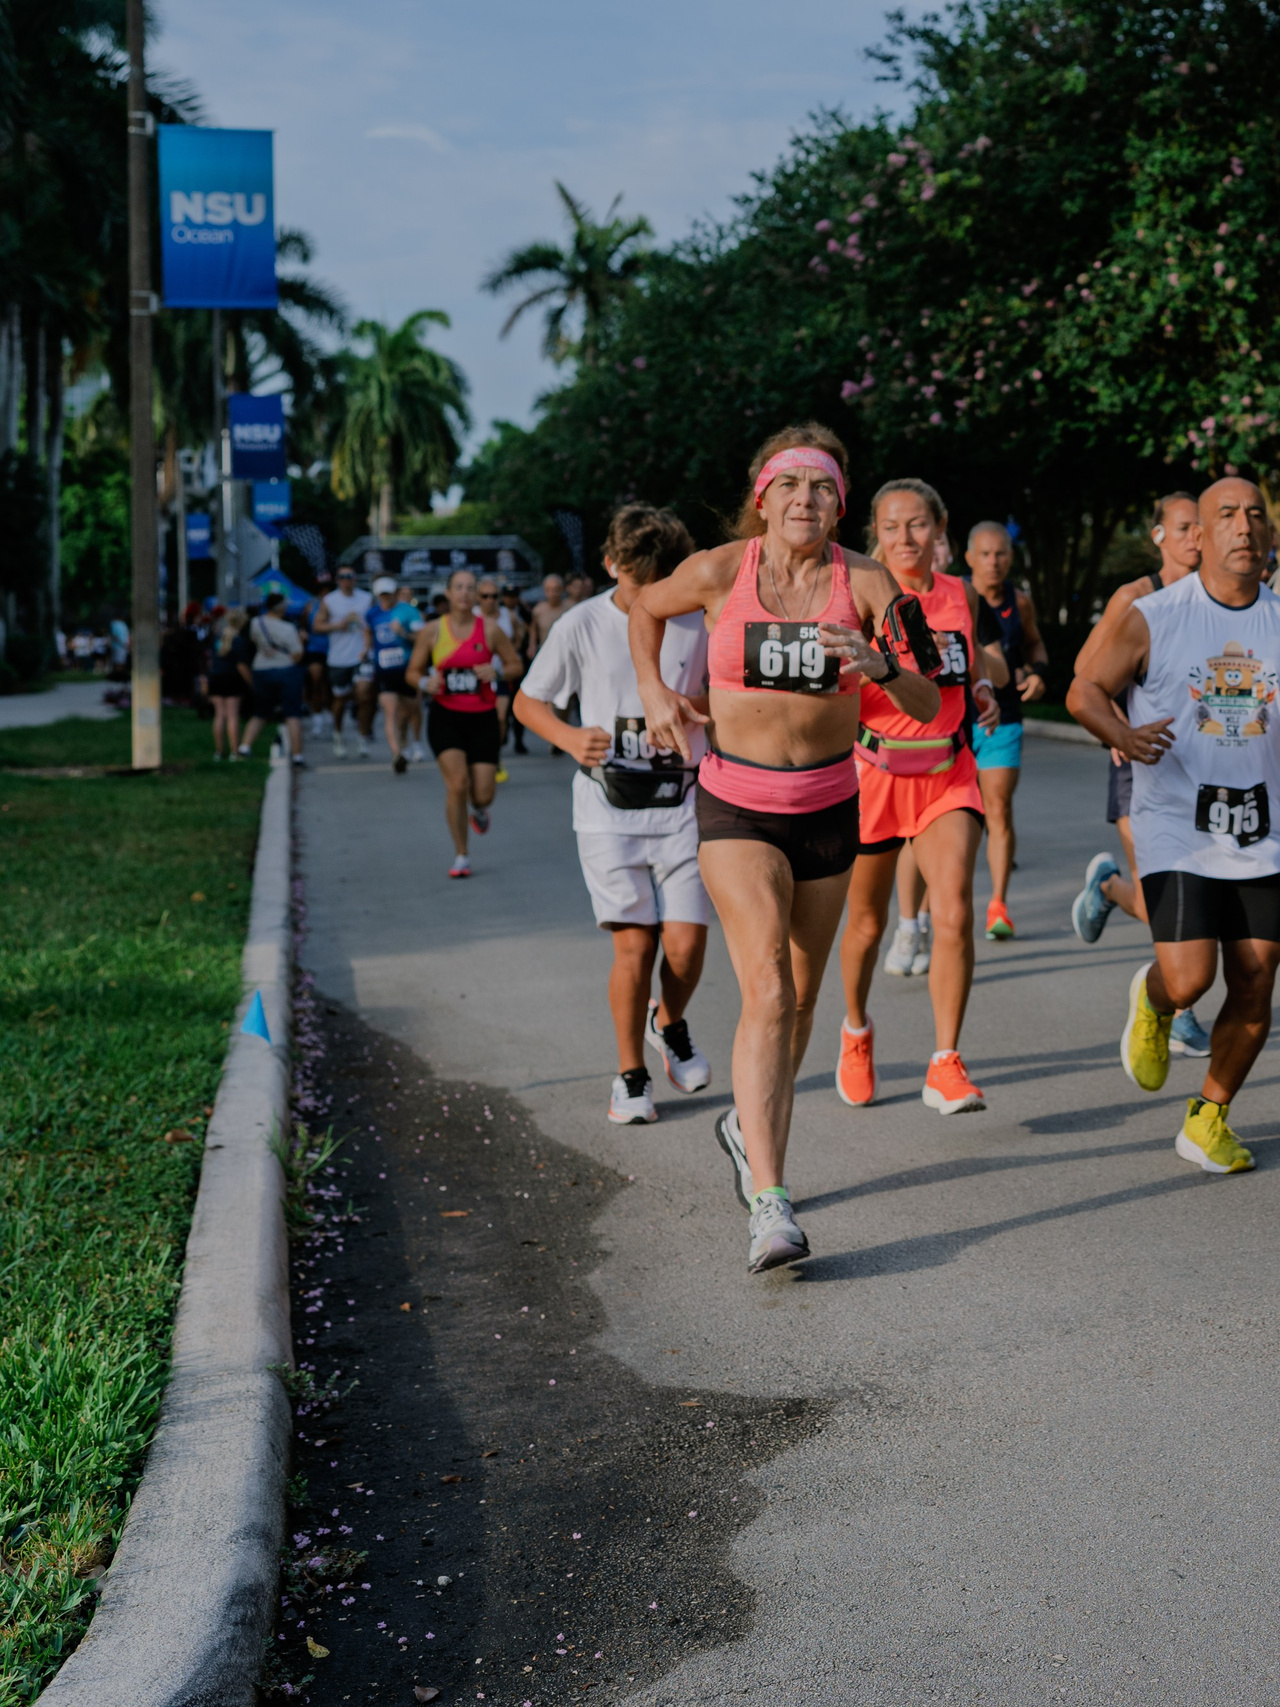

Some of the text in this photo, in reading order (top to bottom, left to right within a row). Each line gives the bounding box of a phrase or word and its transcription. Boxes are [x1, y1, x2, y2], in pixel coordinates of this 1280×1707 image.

[170, 190, 266, 226] NSU
[171, 224, 234, 244] Ocean
[233, 424, 282, 442] NSU
[799, 626, 820, 639] 5K
[759, 639, 826, 679] 619
[1208, 800, 1260, 836] 915
